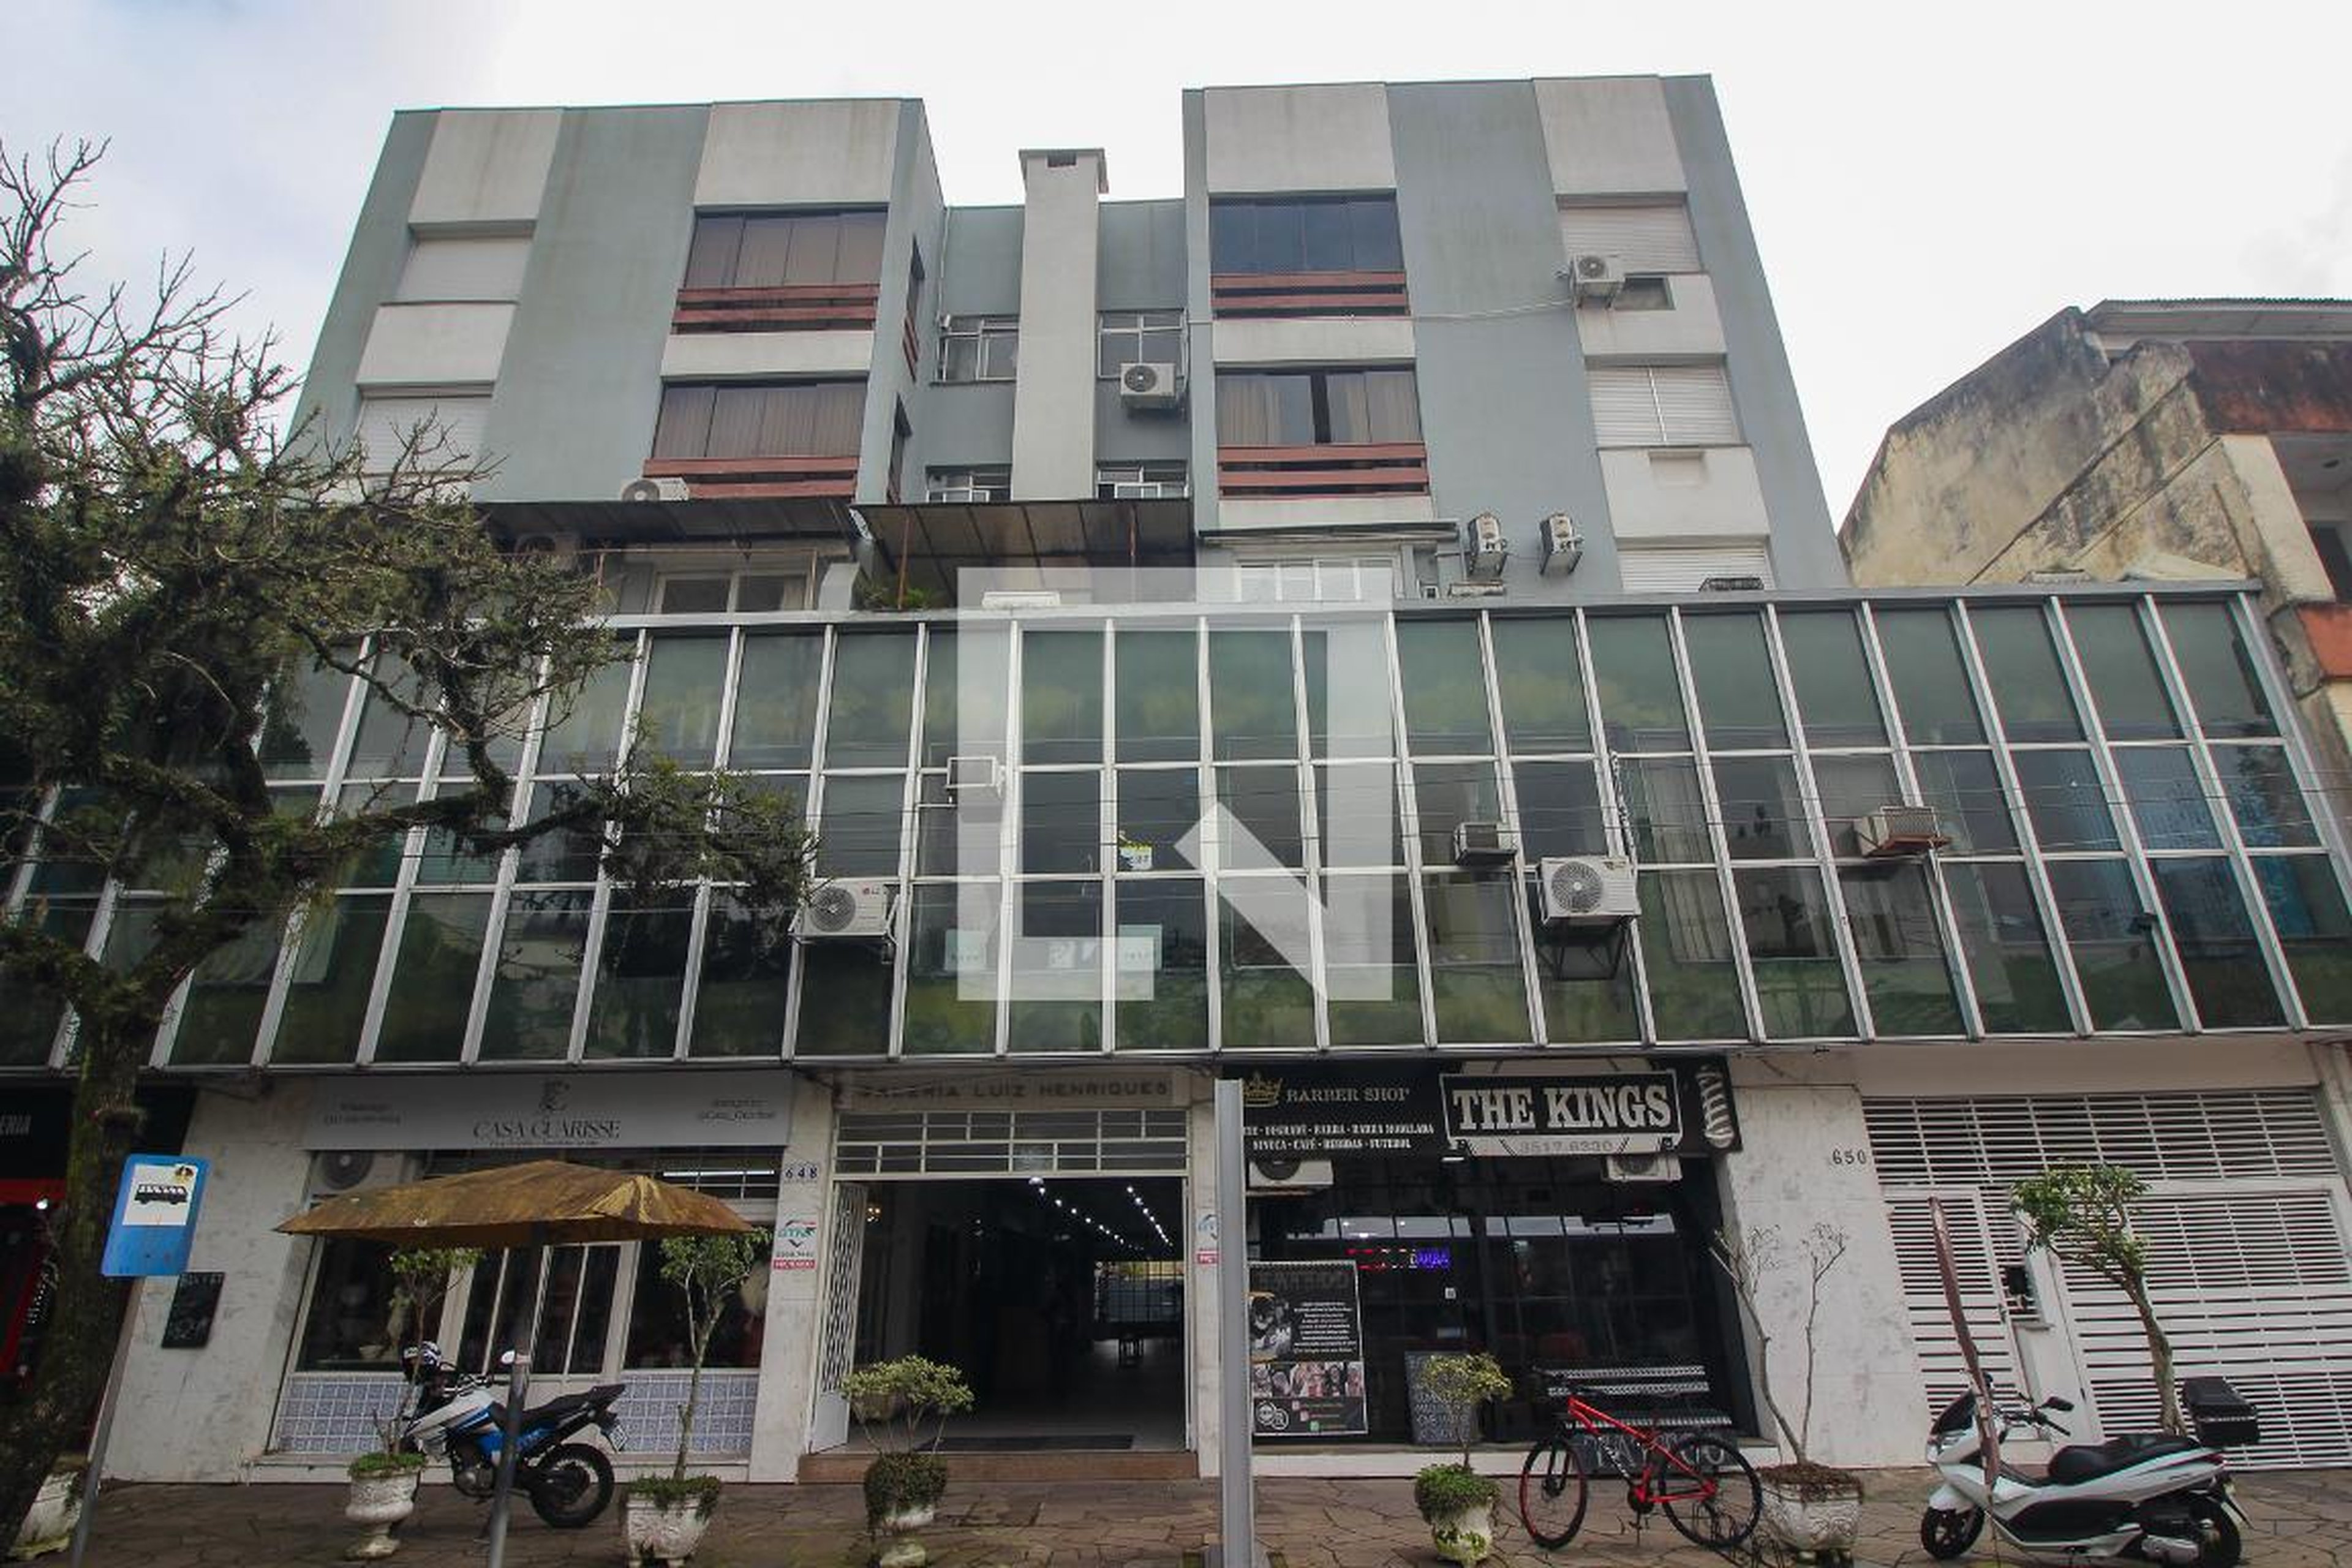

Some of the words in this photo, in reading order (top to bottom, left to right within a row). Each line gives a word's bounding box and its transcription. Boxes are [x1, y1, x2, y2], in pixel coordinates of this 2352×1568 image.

[974, 1082, 1027, 1097] LUIZ
[1039, 1081, 1167, 1096] HENRIQUES
[1287, 1088, 1359, 1102] BARBER
[1365, 1087, 1409, 1101] SHOP
[1453, 1087, 1536, 1130] THE
[1543, 1085, 1672, 1128] KINGS
[472, 1121, 524, 1137] CASA
[1833, 1148, 1867, 1164] 650
[785, 1167, 818, 1179] 648
